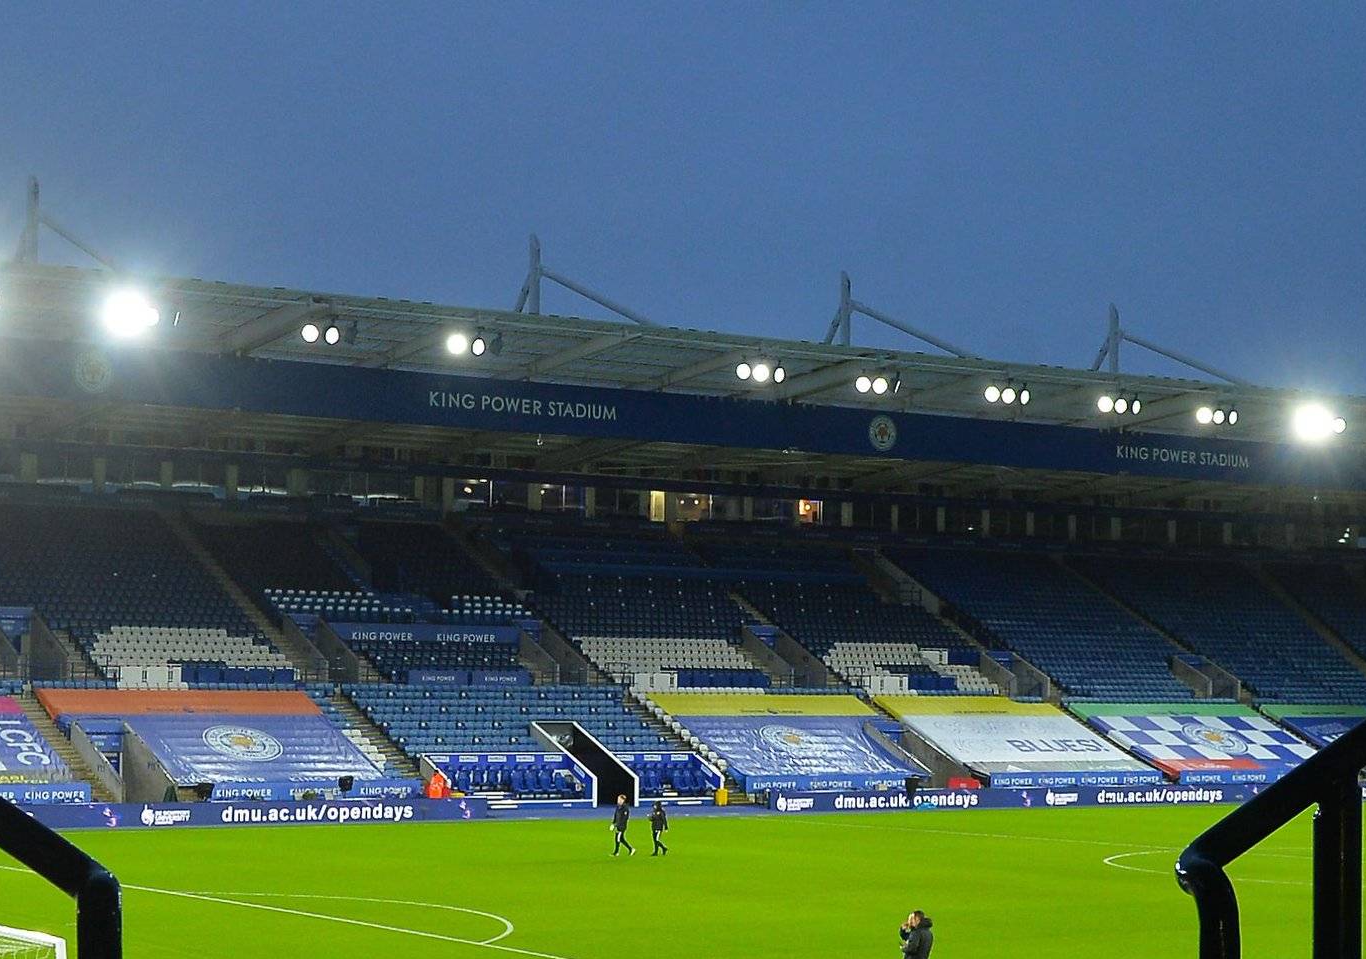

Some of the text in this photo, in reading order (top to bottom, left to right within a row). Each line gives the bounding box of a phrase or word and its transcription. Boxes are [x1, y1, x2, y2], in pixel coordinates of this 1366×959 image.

[429, 391, 617, 421] KING POWER STADIUM
[1116, 445, 1249, 469] KING POWER STADIUM
[352, 632, 413, 642] KING POWER
[437, 633, 495, 643] KING POWER
[1007, 739, 1110, 752] BLUES!
[25, 791, 49, 799] KING
[52, 791, 85, 800] POWER
[216, 788, 272, 797] KING POWER
[360, 787, 381, 795] KING
[1097, 789, 1223, 805] dmu.ac.uk/opendays
[221, 803, 414, 823] dmu.ac.uk/opendays
